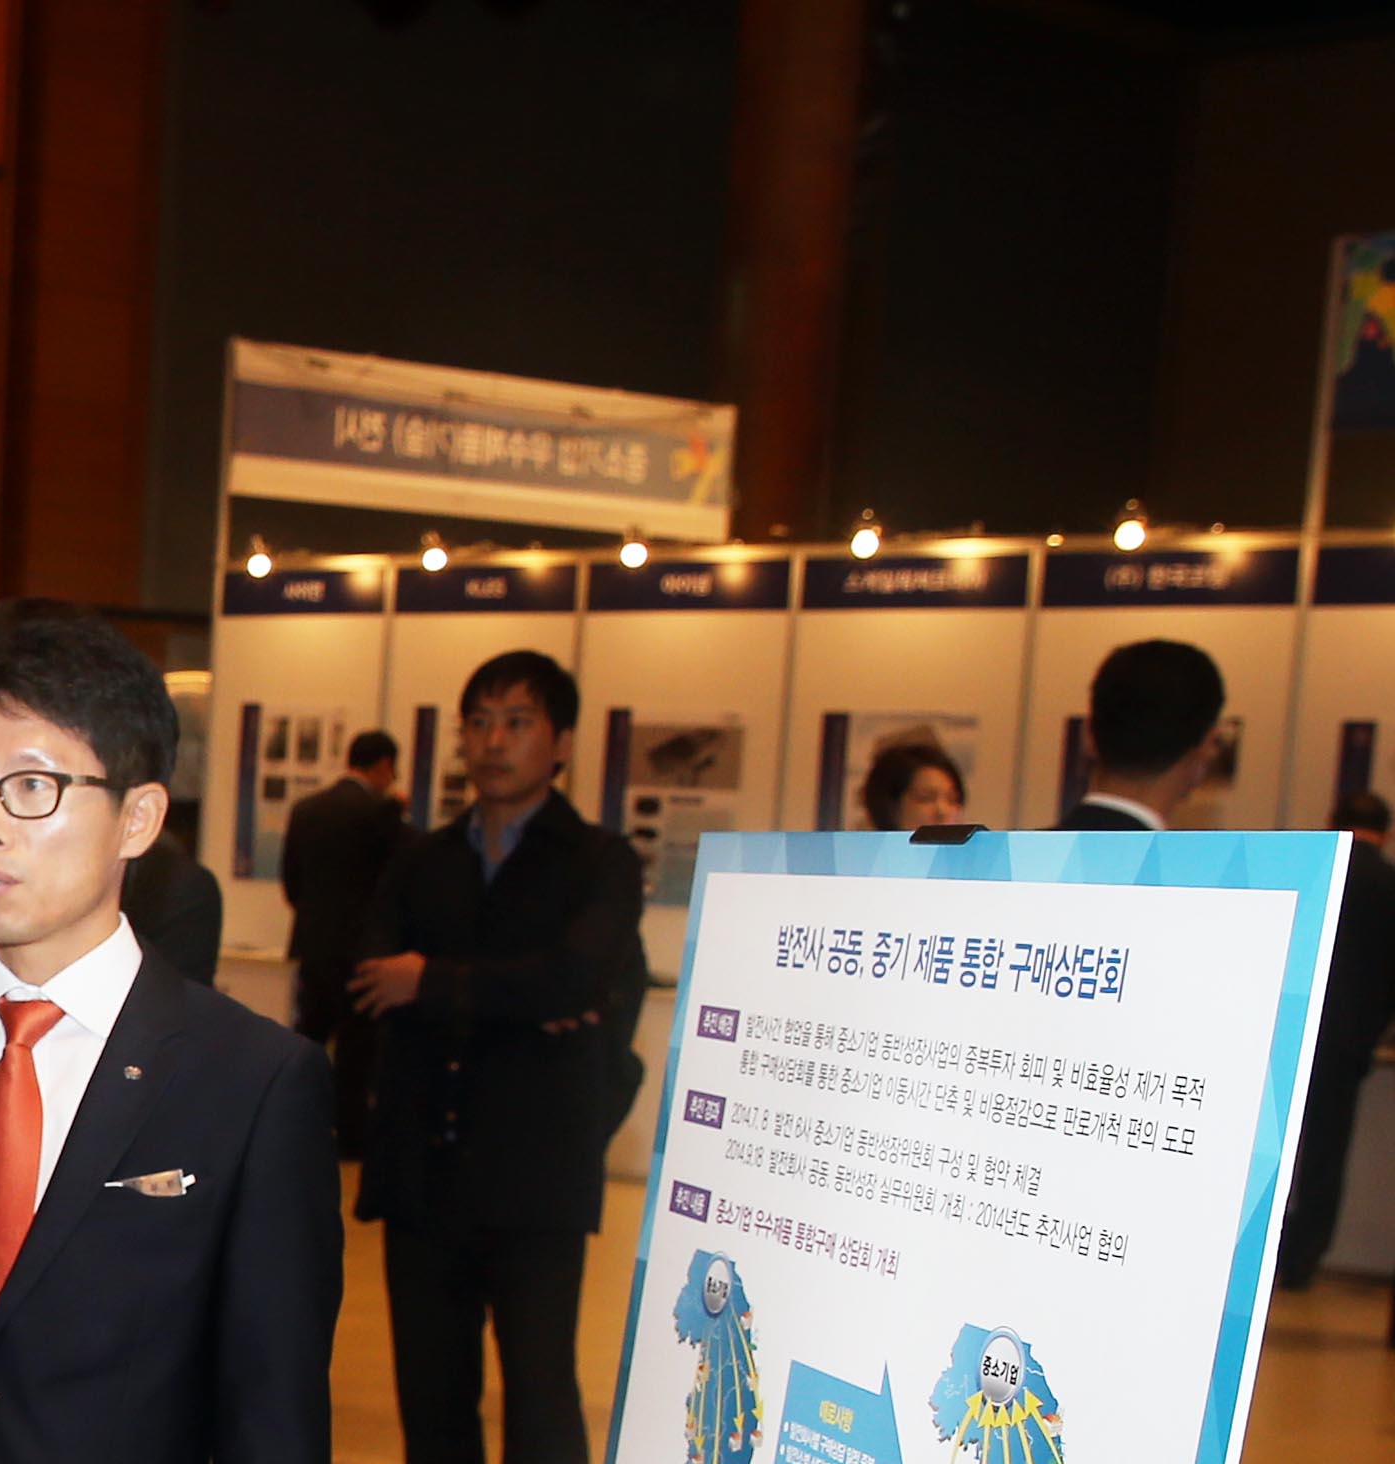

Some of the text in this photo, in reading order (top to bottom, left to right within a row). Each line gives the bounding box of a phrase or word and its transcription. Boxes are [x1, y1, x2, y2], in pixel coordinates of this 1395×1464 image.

[776, 924, 1129, 1003] 발전사 공동, 중기 제품 통합 구매상담회
[739, 1049, 759, 1076] 통합
[817, 1063, 836, 1091] 통한
[840, 1067, 883, 1100] 중소기업
[885, 1074, 932, 1109] 이동시간
[935, 1084, 959, 1114] 단축
[962, 1088, 976, 1118] 및
[979, 1091, 1058, 1131] 비용절감으로
[1063, 1106, 1123, 1146] 판로개척
[1126, 1116, 1159, 1152] 편의
[1161, 1125, 1196, 1156] 도모
[814, 1023, 835, 1050] 통해
[837, 1026, 880, 1058] 중소기업
[881, 1033, 961, 1070] 동반성장사업의
[964, 1044, 1016, 1080] 중복투자
[1019, 1053, 1048, 1085] 회피
[1051, 1057, 1067, 1088] 및
[1071, 1060, 1131, 1099] 비효율성
[1133, 1069, 1166, 1104] 제거
[1171, 1075, 1206, 1111] 목적
[814, 1120, 854, 1153] 중소기업
[858, 1128, 935, 1172] 동반성장위원회
[938, 1147, 963, 1179] 구성
[967, 1153, 979, 1183] 및
[984, 1155, 1010, 1189] 협약
[1013, 1163, 1042, 1197] 체결
[715, 1198, 752, 1232] 중소기업
[839, 1236, 873, 1274] 상담회
[874, 1246, 900, 1280] 개최
[835, 1164, 877, 1201] 동반성장
[880, 1178, 937, 1217] 실무위원회
[940, 1191, 966, 1225] 개최
[975, 1201, 1031, 1238] 2014년도
[1035, 1214, 1093, 1257] 추진사업
[1098, 1229, 1129, 1266] 협의
[983, 1355, 1019, 1385] 중소기업
